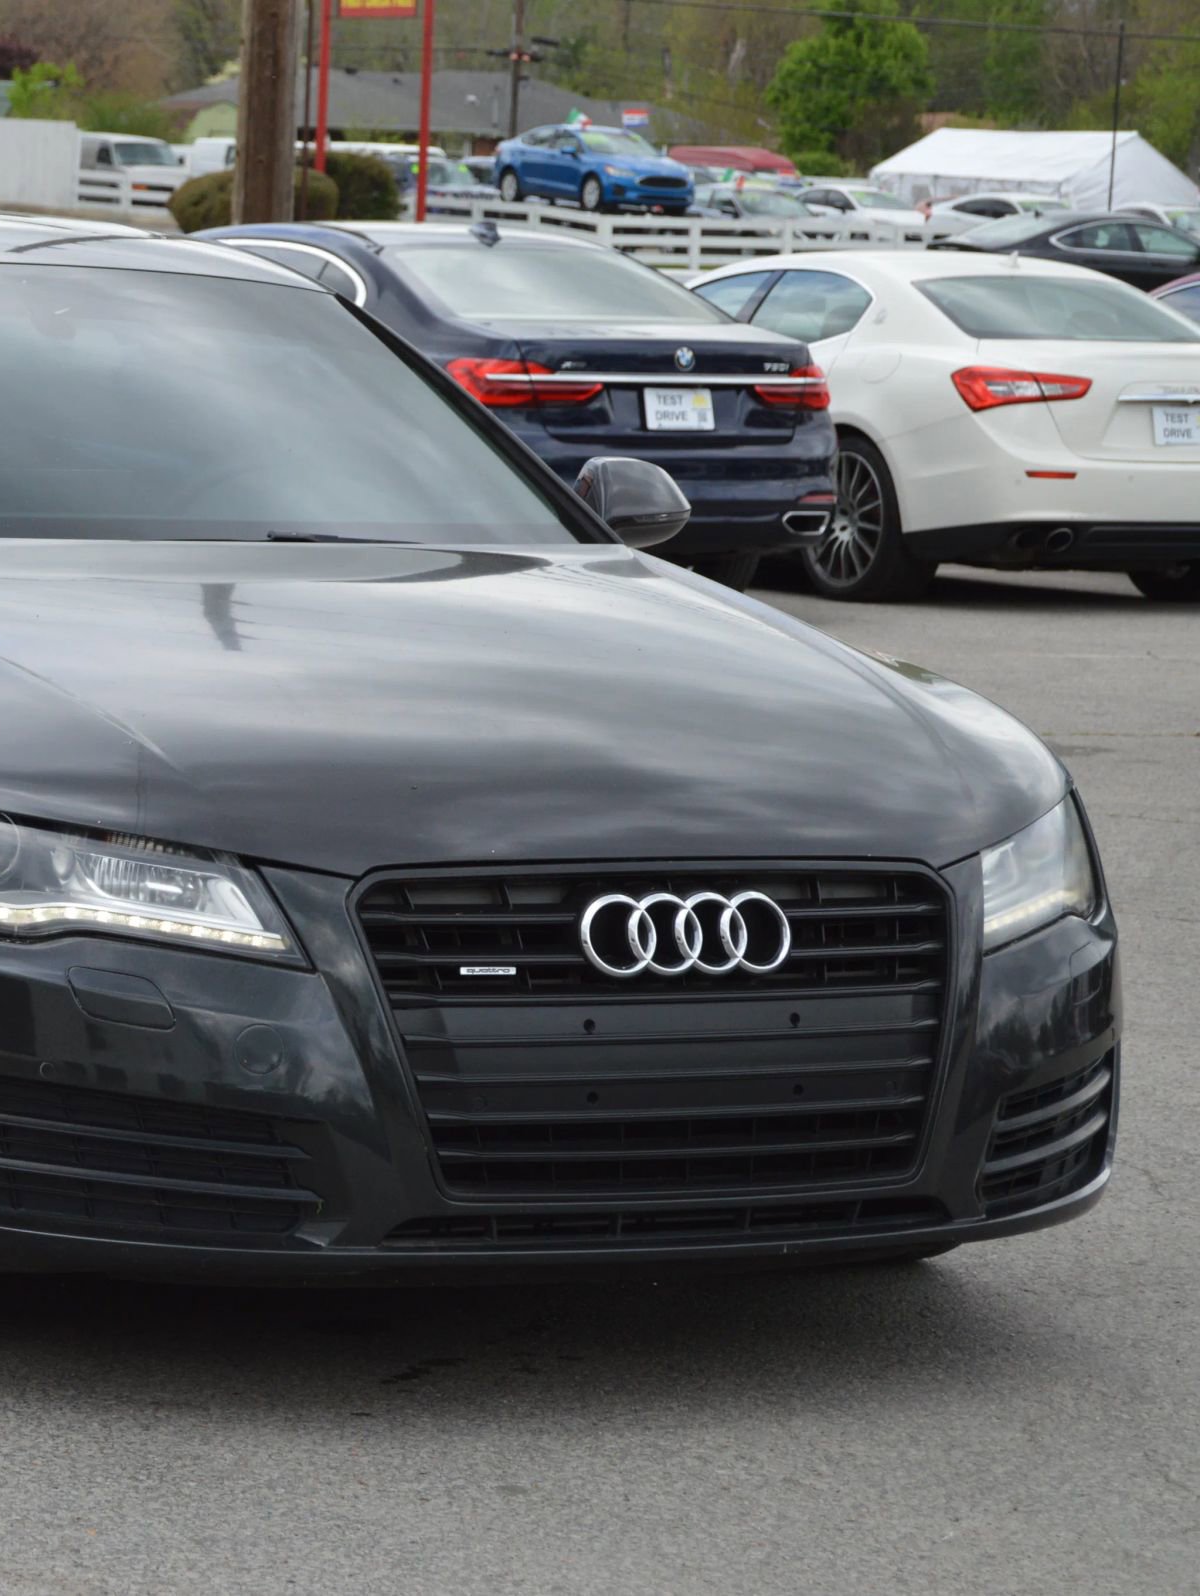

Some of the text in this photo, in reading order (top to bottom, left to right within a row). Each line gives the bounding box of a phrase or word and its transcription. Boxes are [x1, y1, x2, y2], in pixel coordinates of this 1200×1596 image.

[656, 394, 683, 406] TEST
[656, 410, 688, 421] DRIVE
[1164, 412, 1188, 423] TEST
[1163, 428, 1193, 438] DRIVE
